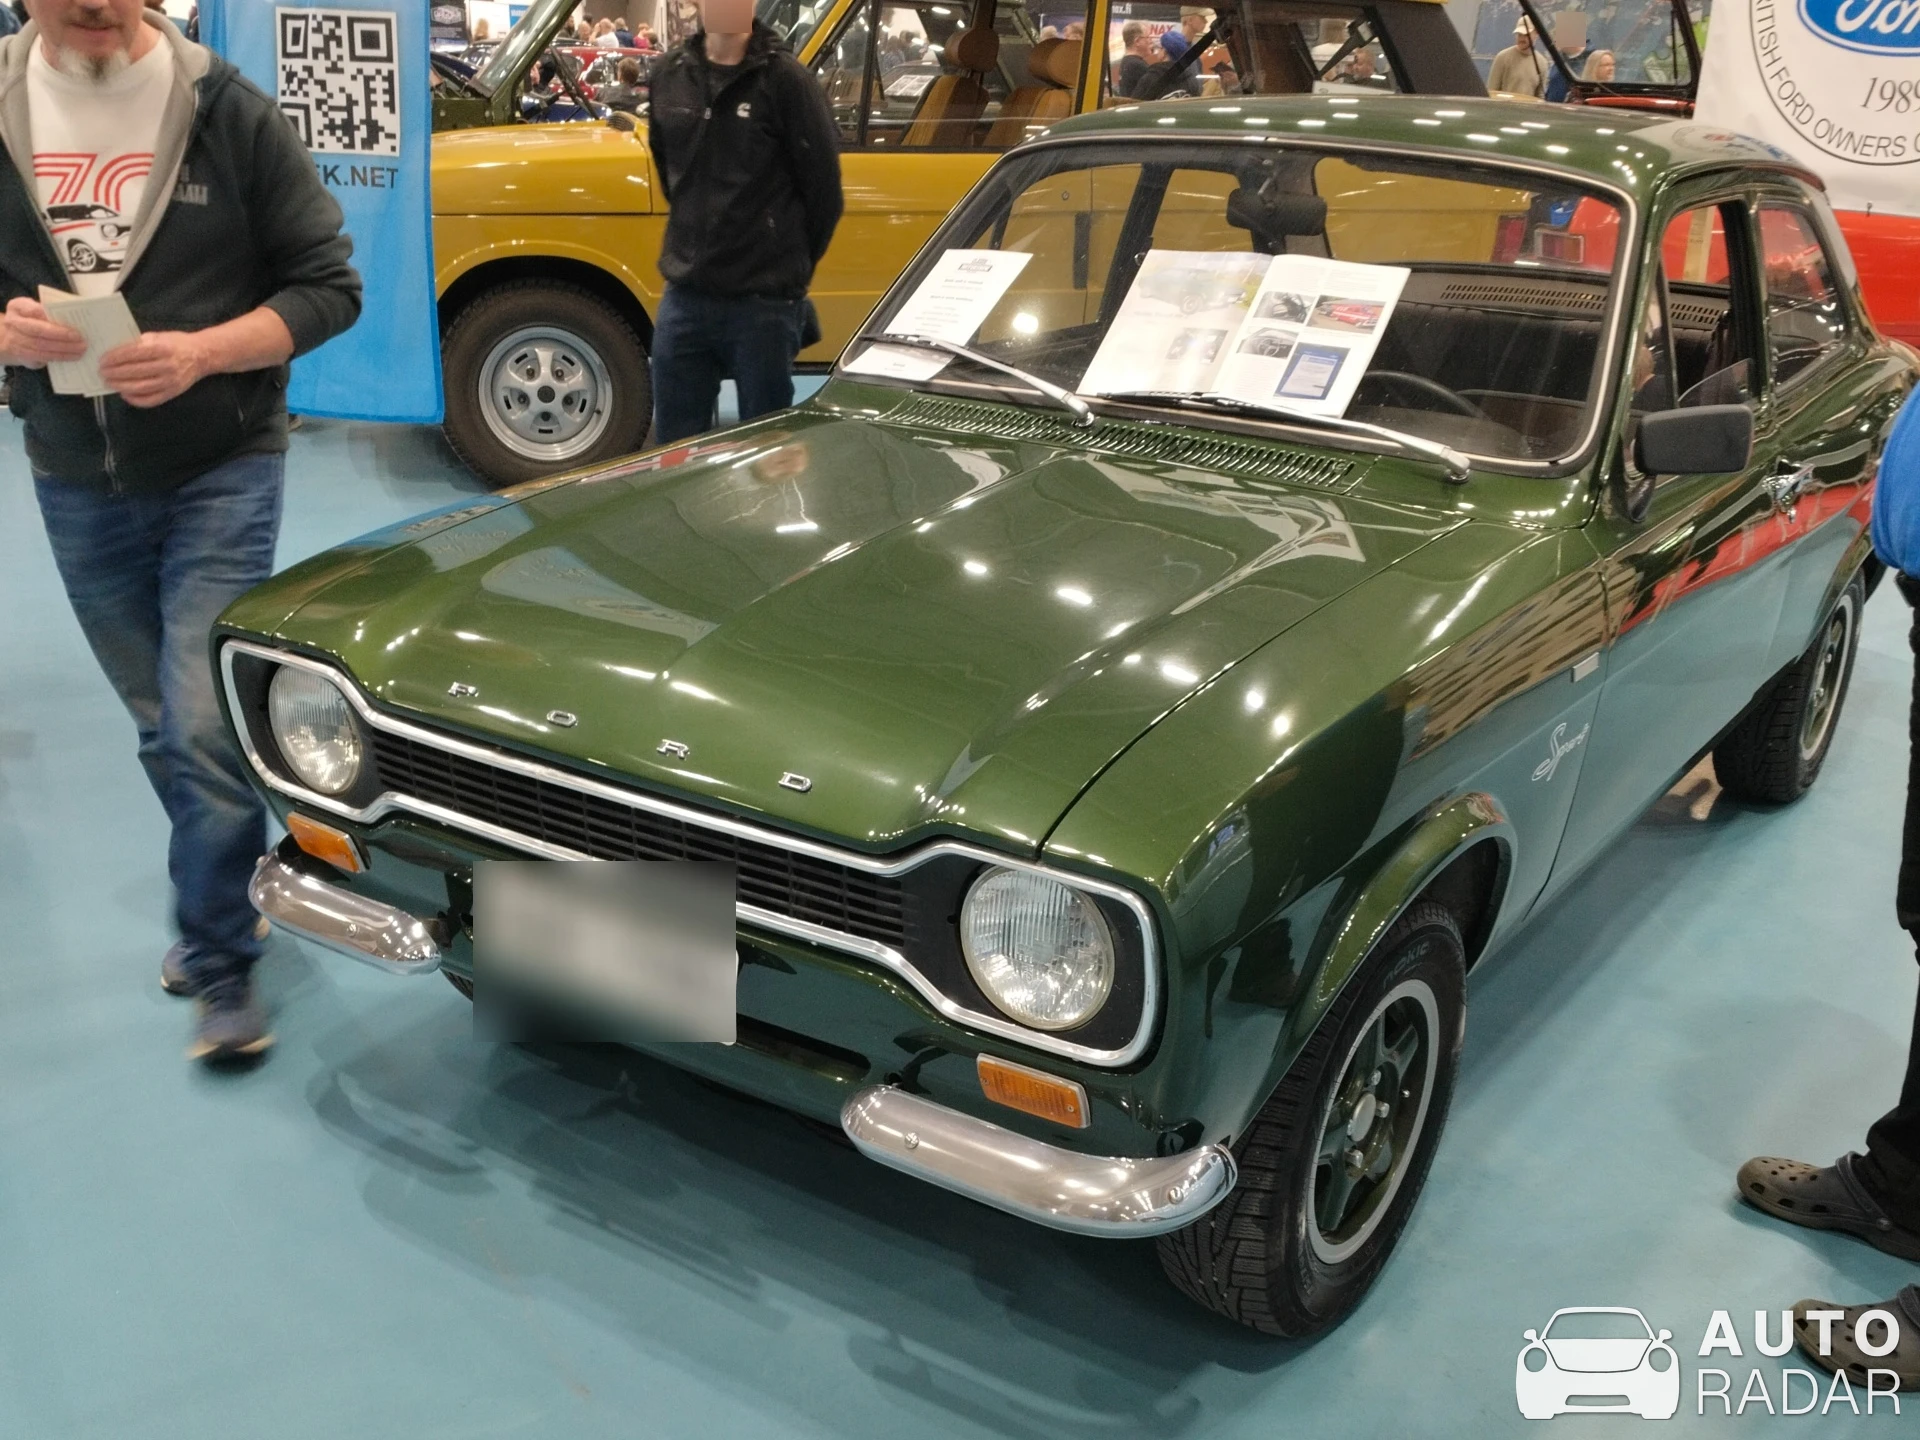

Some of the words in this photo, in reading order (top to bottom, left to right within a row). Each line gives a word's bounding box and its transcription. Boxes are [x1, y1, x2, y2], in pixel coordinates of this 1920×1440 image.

[1756, 0, 1782, 68] ITISH
[1769, 66, 1815, 125] FORD
[1813, 118, 1907, 157] OWNERS
